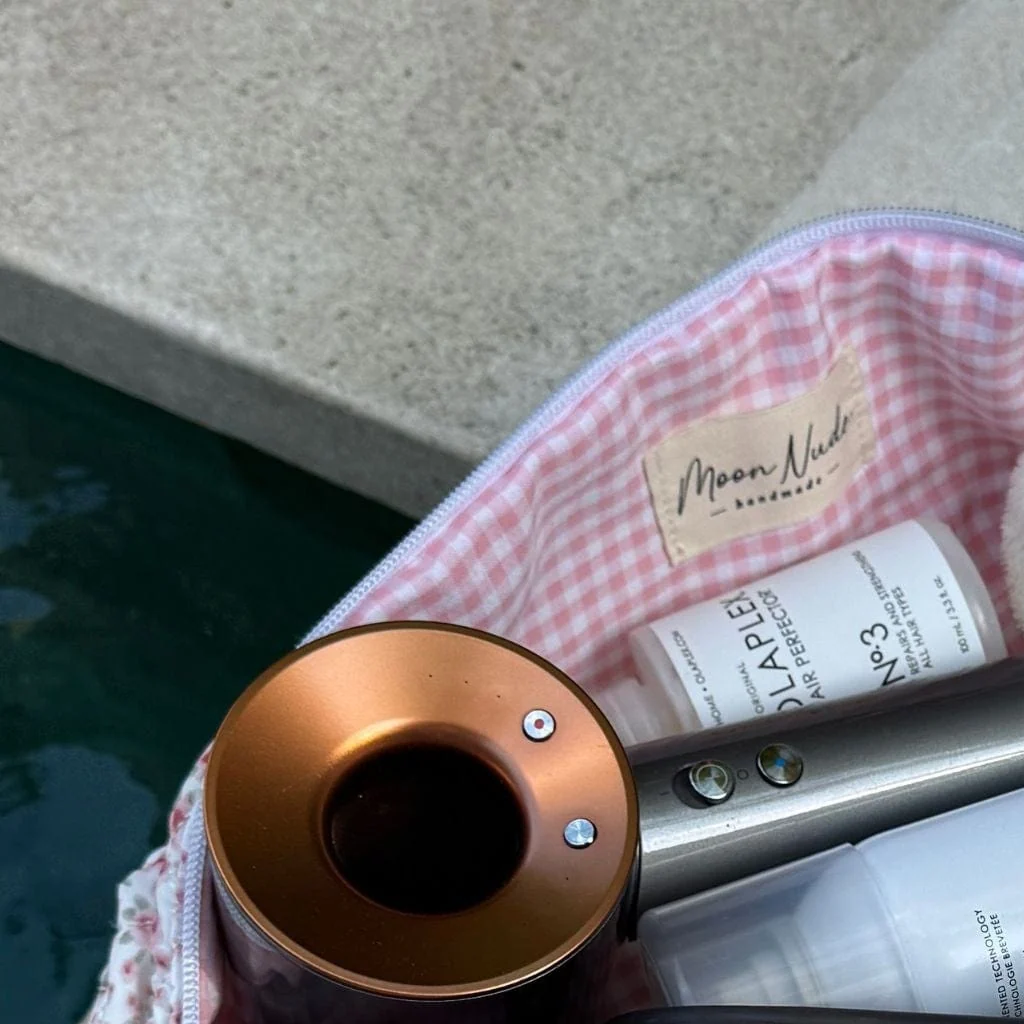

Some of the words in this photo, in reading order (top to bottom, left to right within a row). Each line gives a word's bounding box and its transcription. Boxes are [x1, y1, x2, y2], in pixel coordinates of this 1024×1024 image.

[677, 456, 778, 516] Moon
[883, 601, 903, 627] AND
[891, 585, 912, 618] TYPES
[757, 586, 811, 668] PERFECTOR
[906, 618, 925, 647] HAIR
[918, 647, 934, 669] ALL
[736, 661, 765, 714] ORIGINAL
[802, 669, 826, 700] AIR
[973, 909, 1004, 983] TECHNOLOGY
[1004, 961, 1022, 1018] CHNOLOGIE
